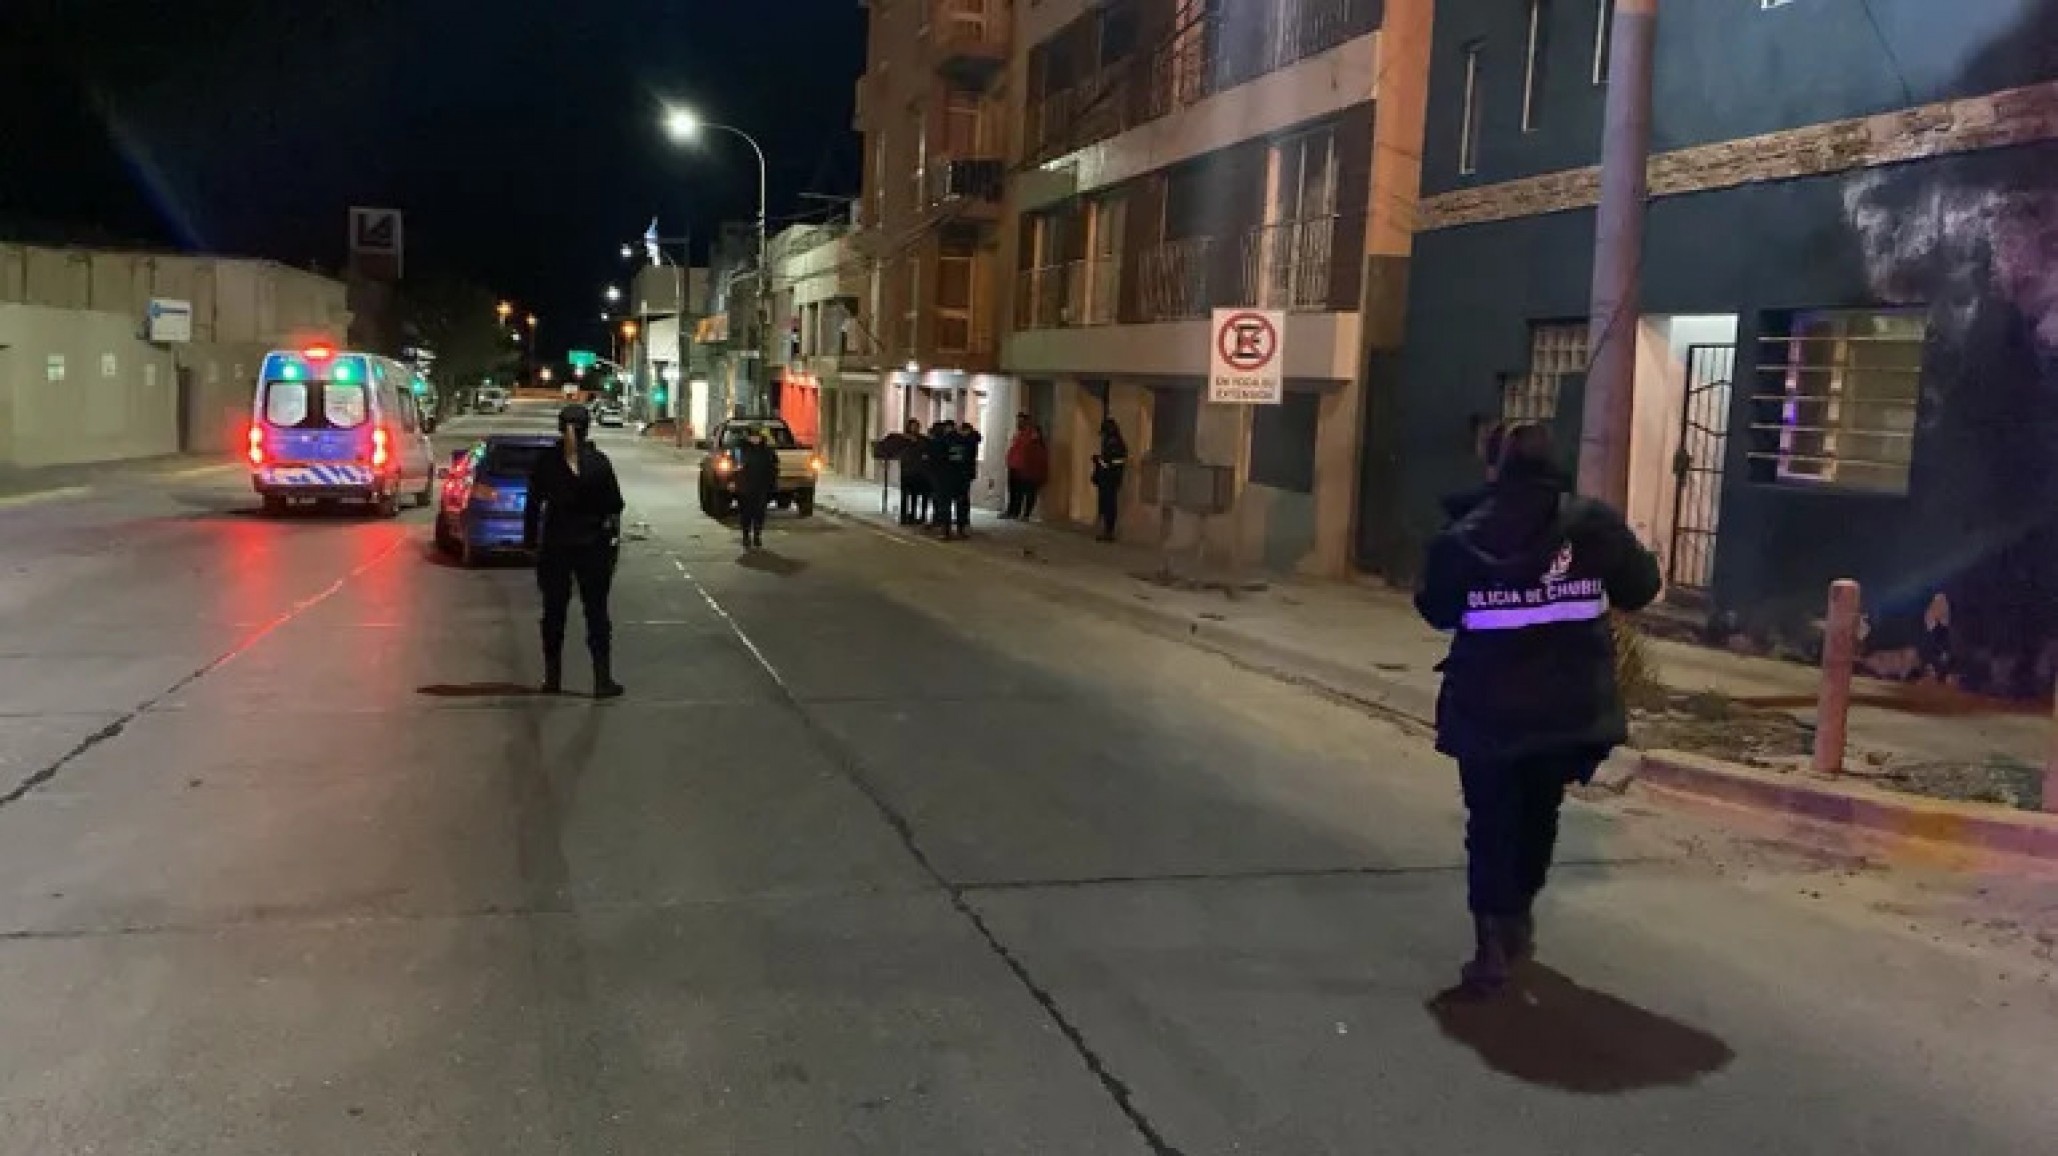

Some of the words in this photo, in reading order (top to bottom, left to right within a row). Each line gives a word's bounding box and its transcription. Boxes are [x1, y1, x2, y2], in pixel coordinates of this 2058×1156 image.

[1466, 589, 1522, 608] OLICIA
[1525, 588, 1544, 603] DE
[1547, 578, 1603, 600] CHUBU
